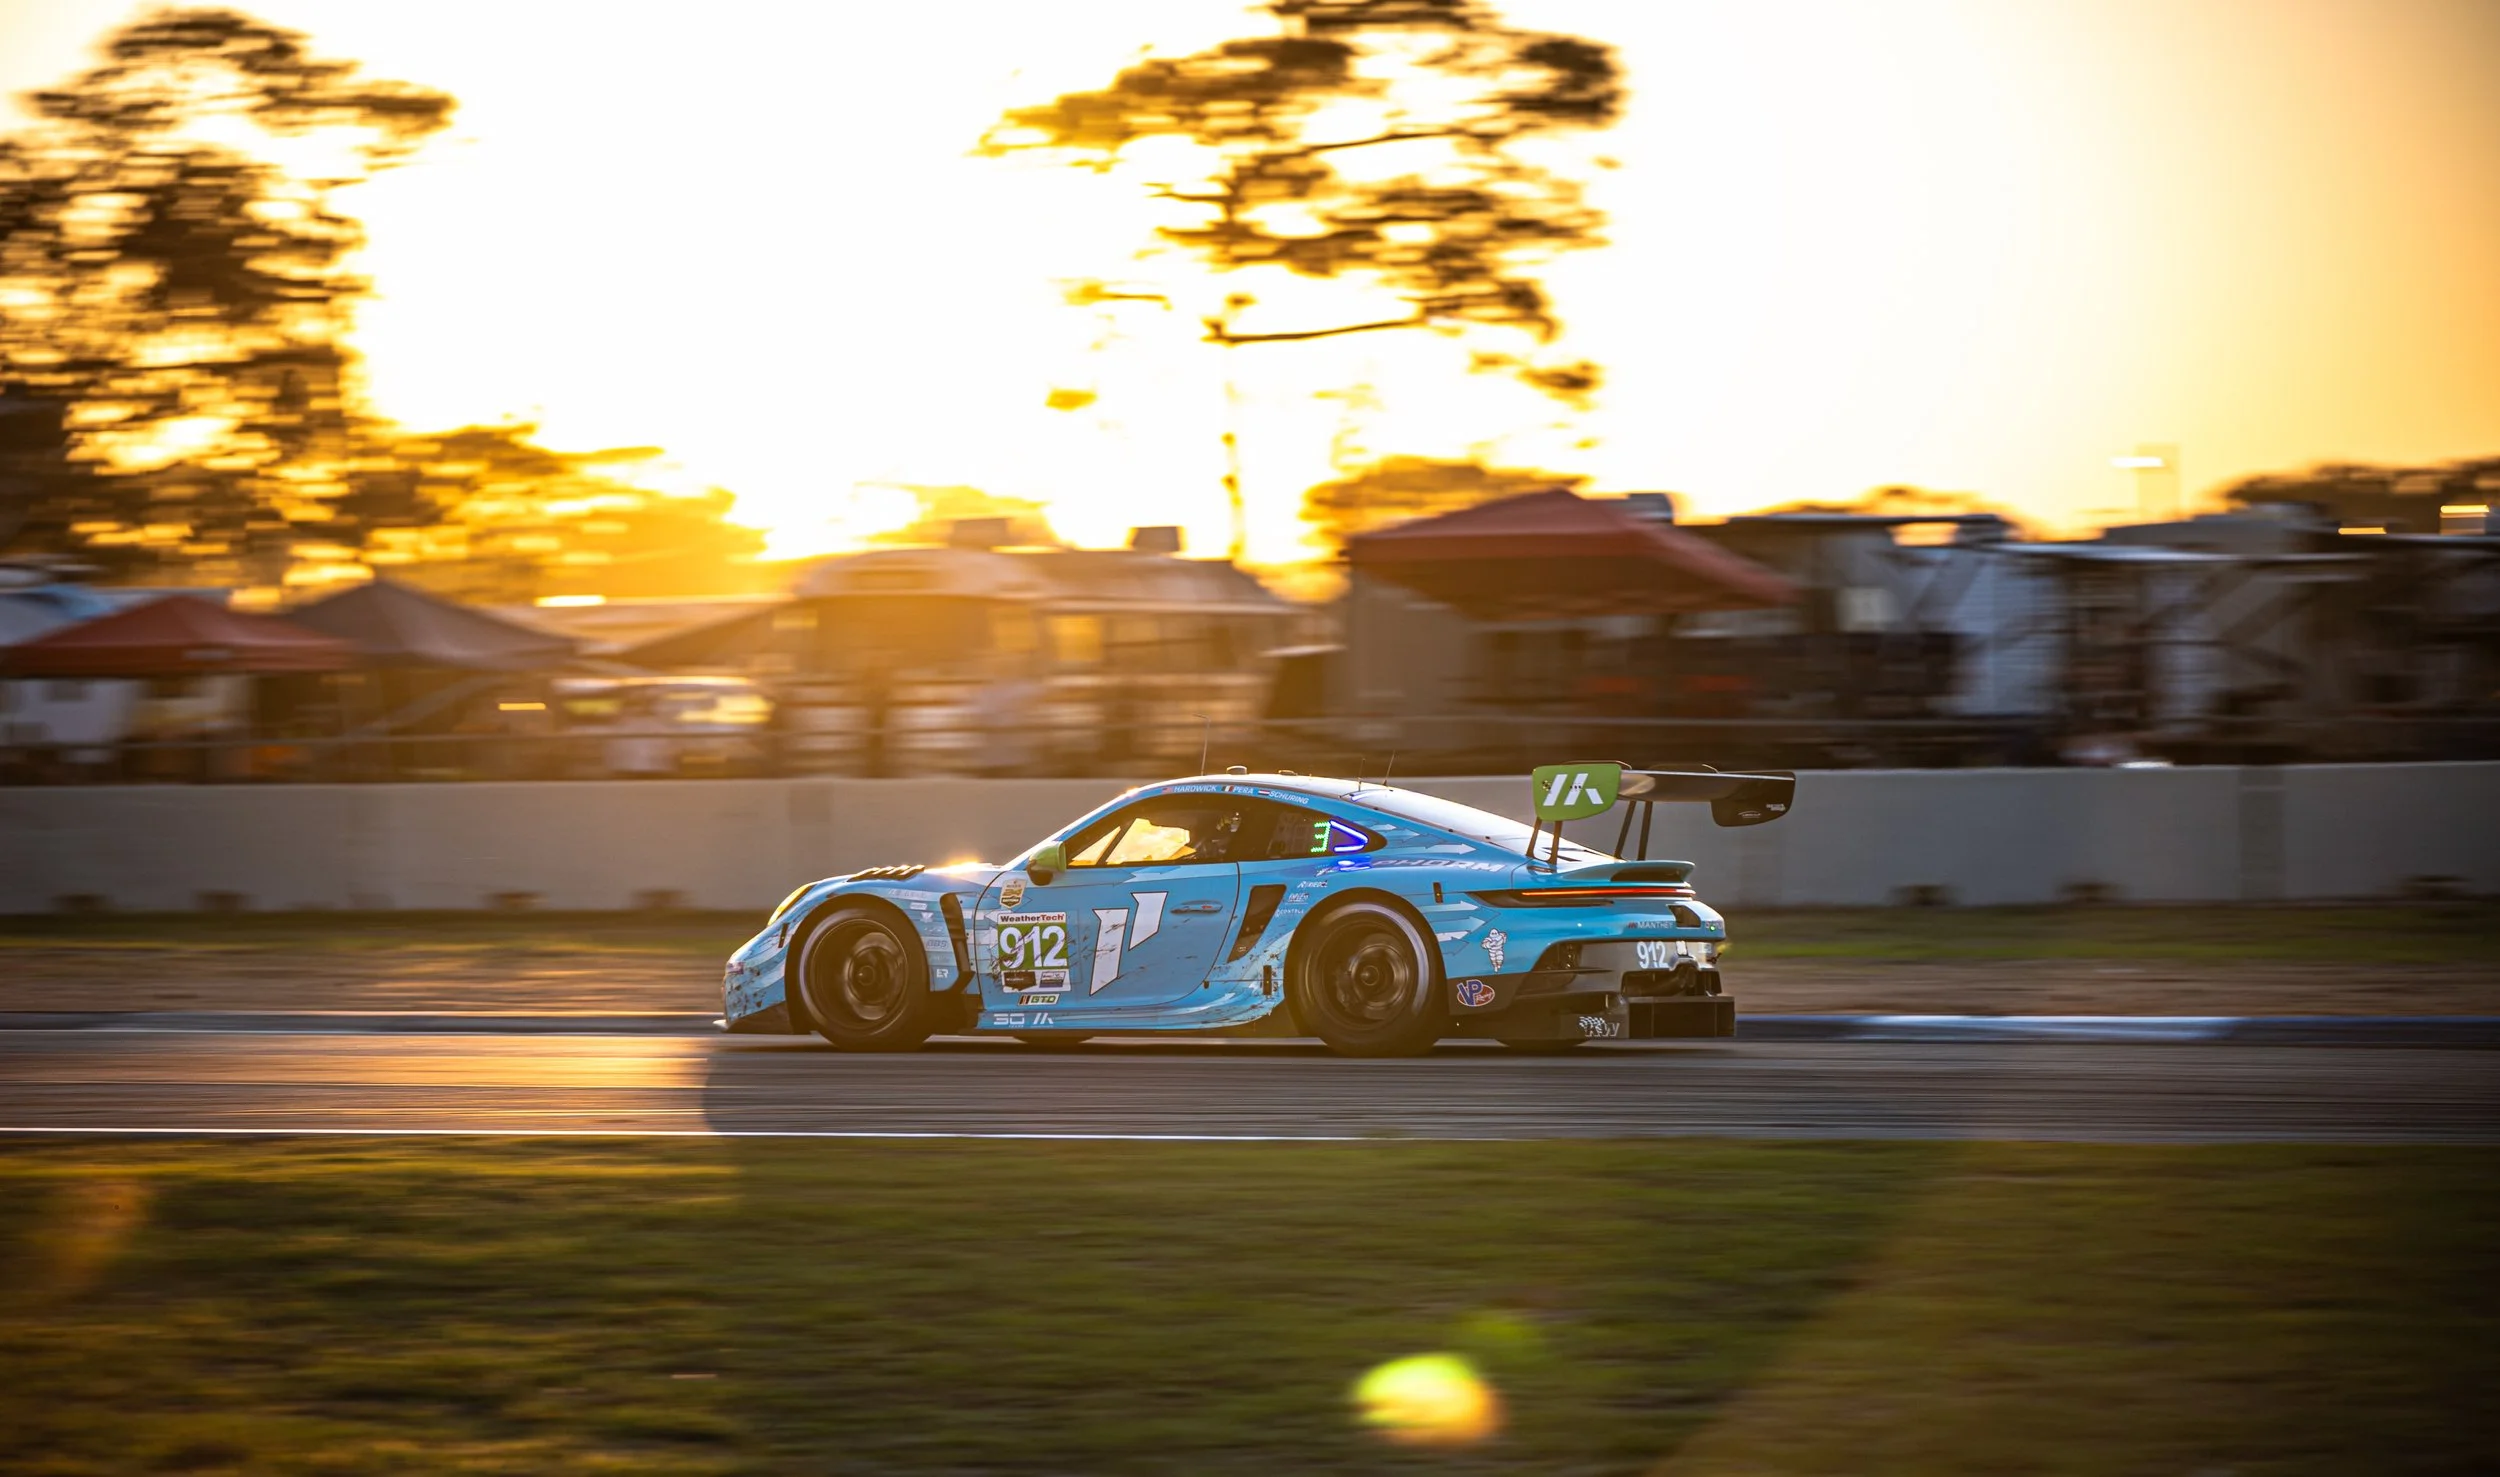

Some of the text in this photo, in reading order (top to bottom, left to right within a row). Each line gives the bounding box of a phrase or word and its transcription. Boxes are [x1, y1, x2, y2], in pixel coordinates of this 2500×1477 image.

[1174, 784, 1217, 793] HARDWICK
[1233, 785, 1254, 794] PERA
[1269, 790, 1309, 805] SCHURING
[1000, 914, 1064, 923] WeatherTech
[1000, 925, 1067, 969] 912
[1637, 941, 1669, 969] 912
[1457, 979, 1483, 1006] VP
